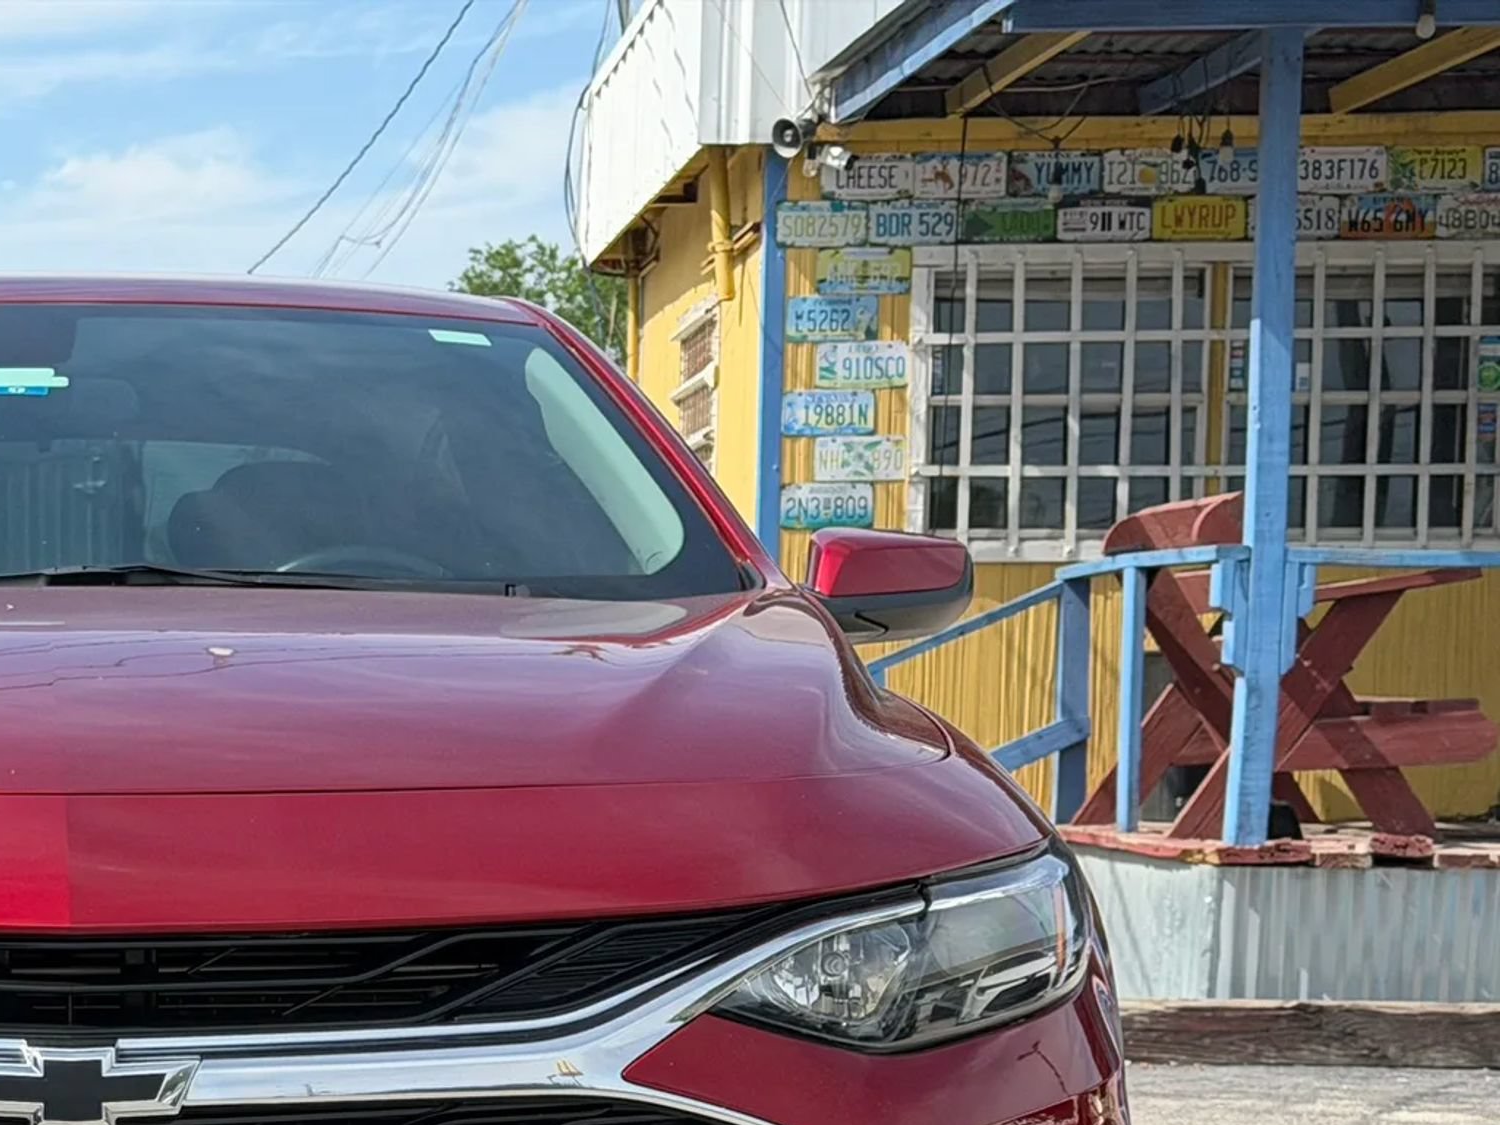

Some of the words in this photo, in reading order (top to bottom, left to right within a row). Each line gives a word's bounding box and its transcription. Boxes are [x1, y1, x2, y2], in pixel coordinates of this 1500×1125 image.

[1034, 161, 1095, 185] YUMMY
[918, 212, 955, 237] 529
[1117, 211, 1146, 232] WTC
